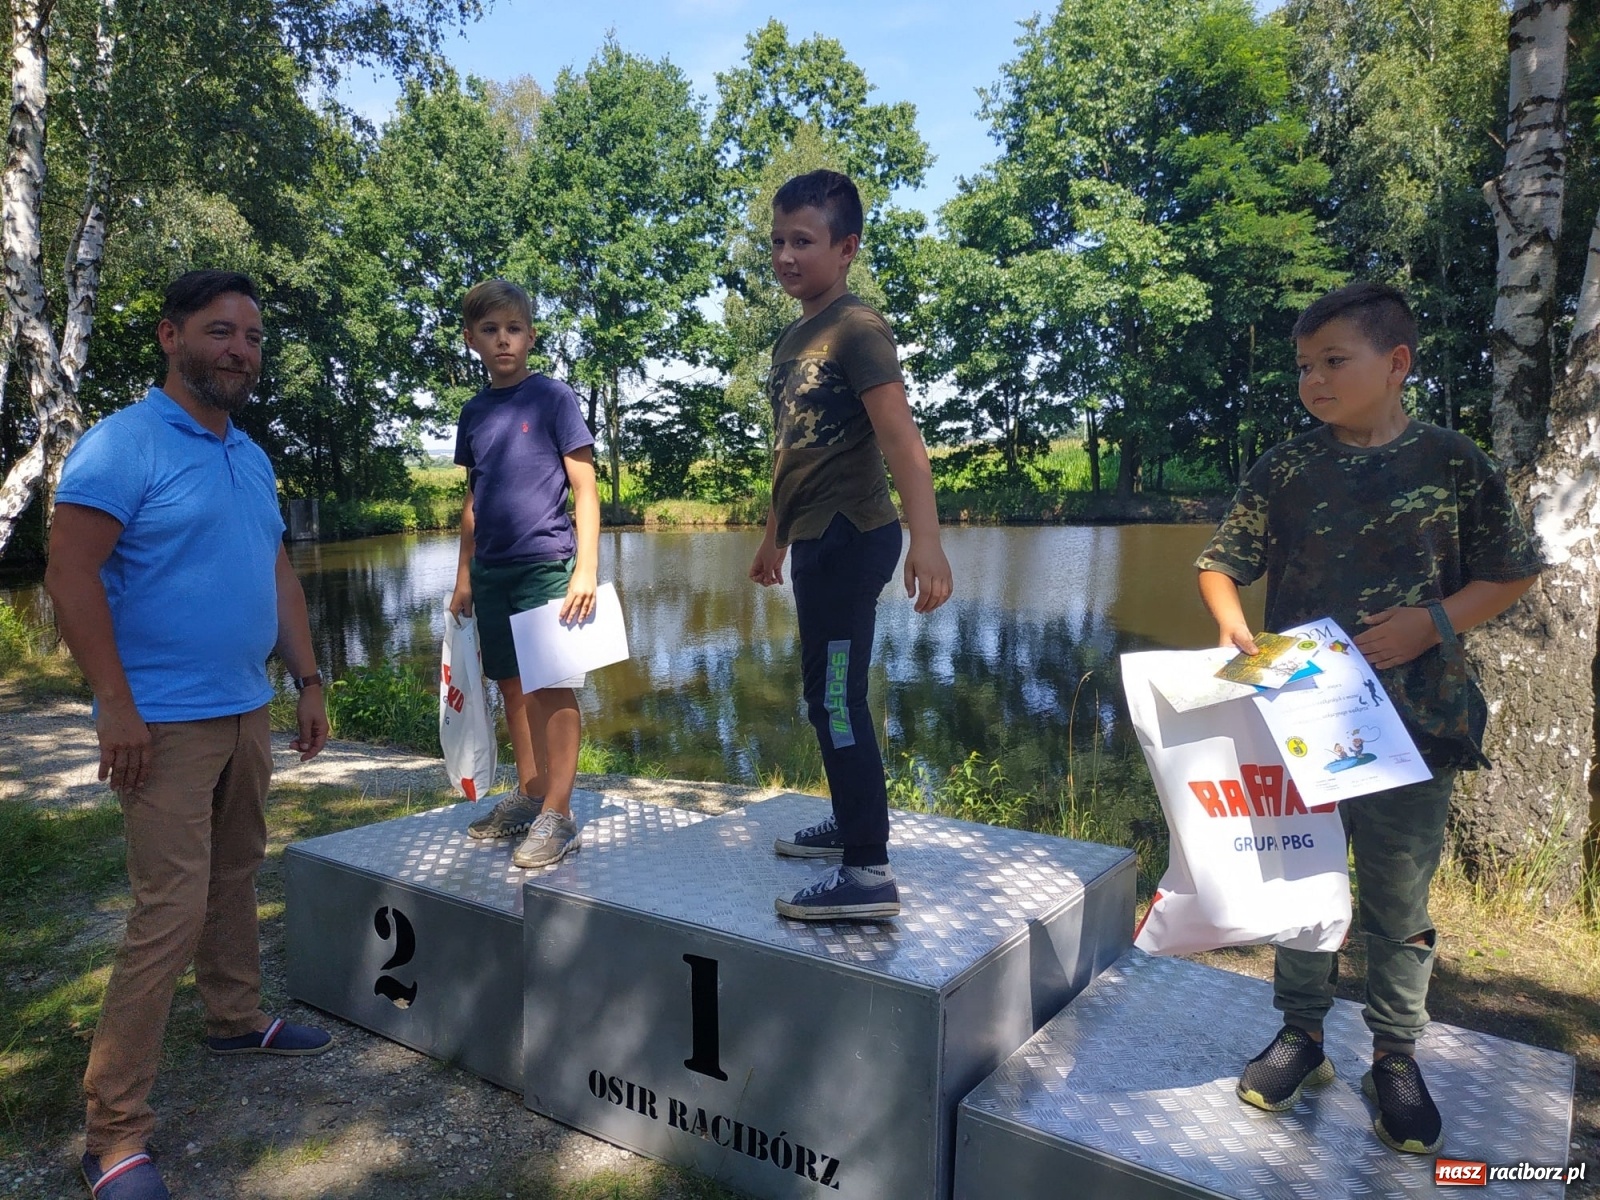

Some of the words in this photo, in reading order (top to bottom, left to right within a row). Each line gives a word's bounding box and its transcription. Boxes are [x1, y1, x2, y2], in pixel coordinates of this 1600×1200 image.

[1282, 834, 1314, 850] PBG
[374, 905, 418, 1009] 2
[682, 953, 729, 1082] 1
[588, 1069, 658, 1120] OSIR
[668, 1097, 840, 1190] RACIBÓRZ
